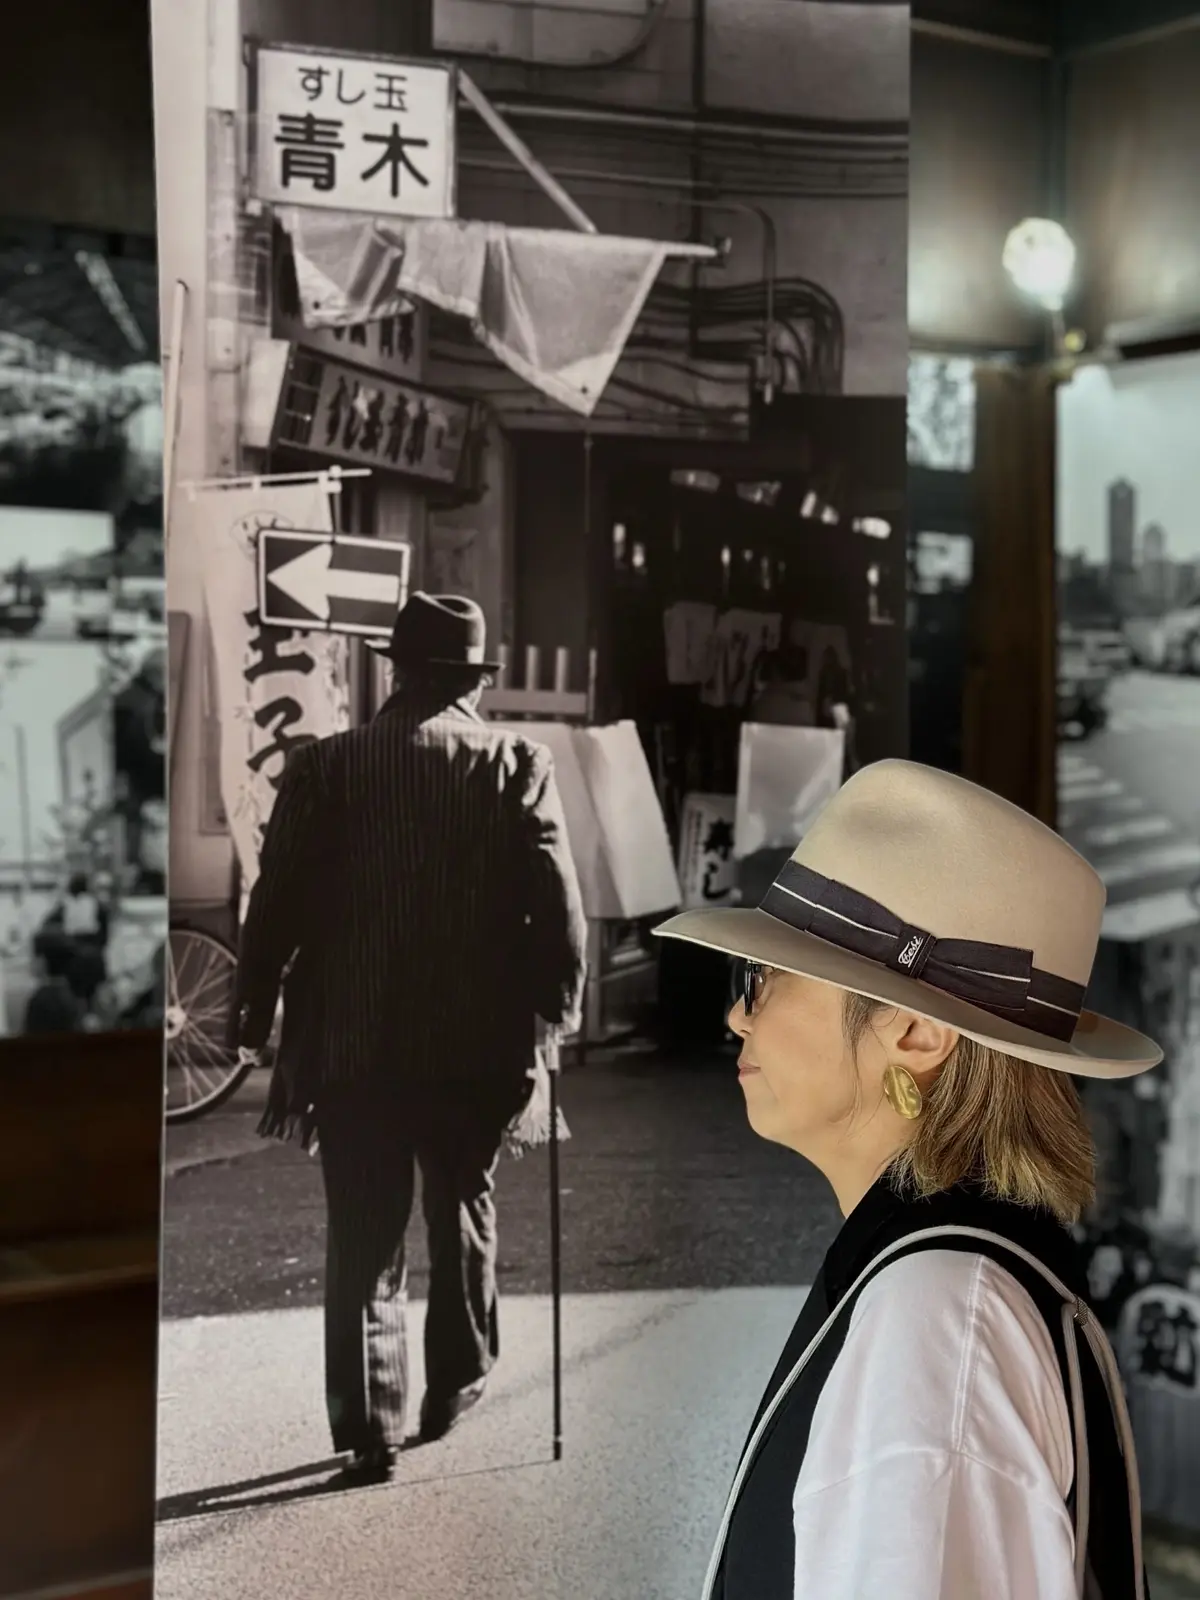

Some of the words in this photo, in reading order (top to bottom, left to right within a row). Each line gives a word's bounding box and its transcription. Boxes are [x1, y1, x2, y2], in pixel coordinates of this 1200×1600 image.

[298, 65, 408, 112] すし玉
[274, 112, 429, 198] 青木
